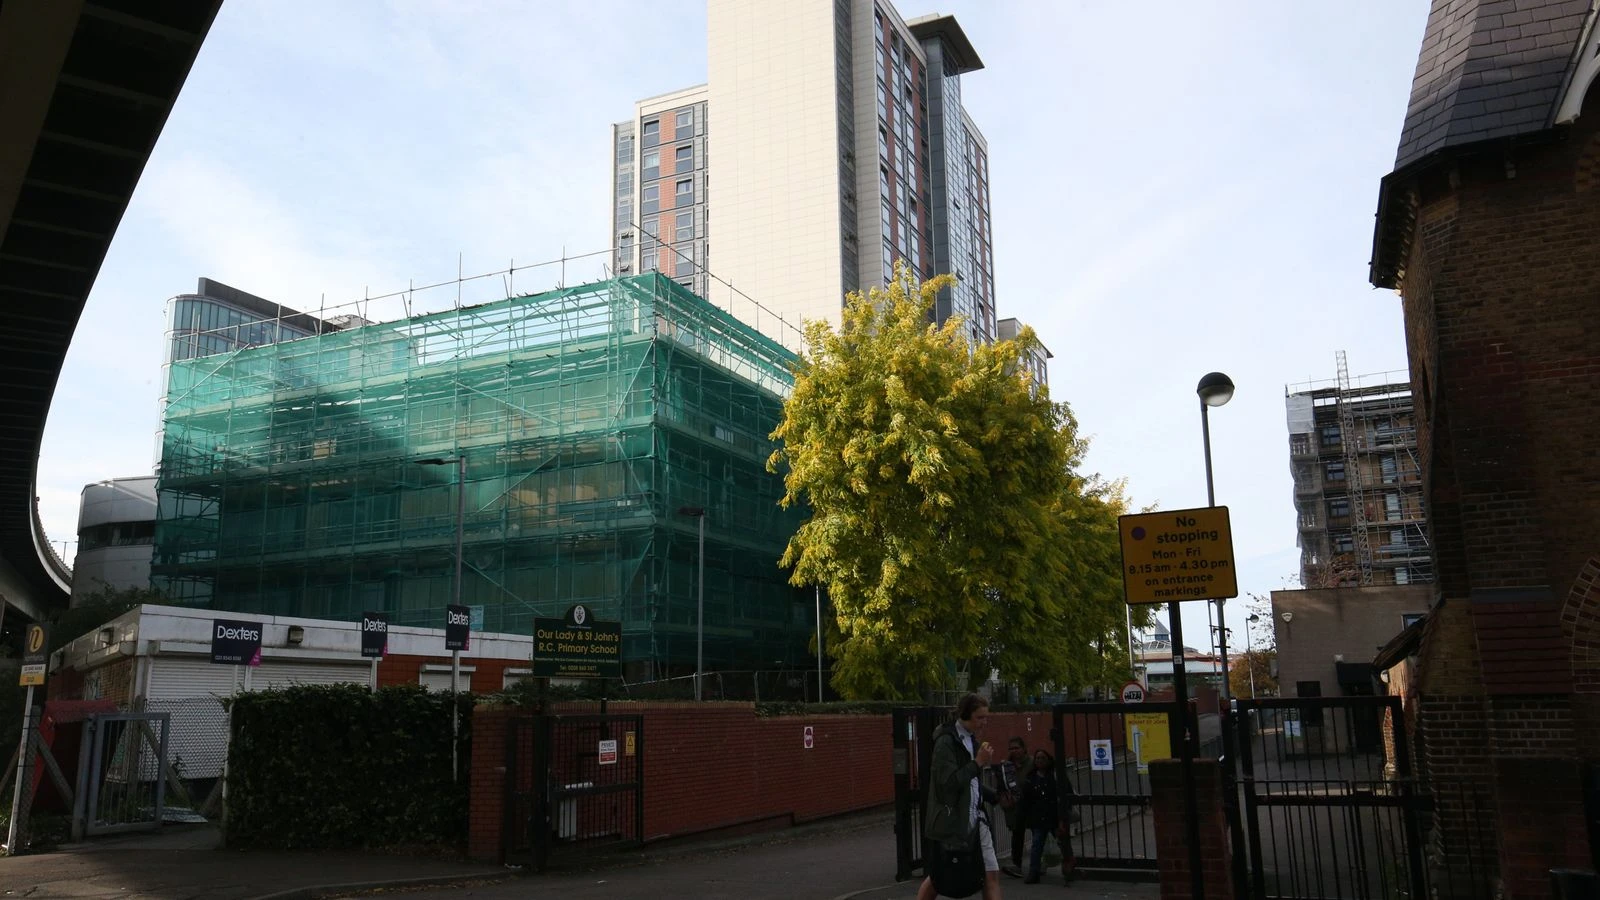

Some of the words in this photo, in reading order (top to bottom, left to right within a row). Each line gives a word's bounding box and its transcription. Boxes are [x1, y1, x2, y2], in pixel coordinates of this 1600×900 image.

[1176, 517, 1197, 528] No
[1157, 530, 1219, 544] stopping
[1152, 550, 1177, 560] Mon
[1186, 547, 1201, 557] Fri
[1129, 564, 1152, 575] 8.15
[1154, 565, 1171, 573] am
[1180, 560, 1208, 571] 4.30
[1210, 559, 1229, 570] pm
[1145, 578, 1160, 586] on
[1163, 574, 1214, 585] entrance
[1154, 586, 1208, 598] markings
[448, 610, 469, 626] Dexters
[364, 617, 387, 633] Dexters
[217, 625, 260, 641] Dexters
[537, 629, 554, 639] Our
[556, 630, 575, 642] Lady
[577, 631, 584, 640] &
[585, 632, 592, 641] St
[594, 632, 619, 642] John's
[538, 642, 556, 652] R.C.
[558, 643, 589, 655] Primary
[590, 644, 617, 654] School
